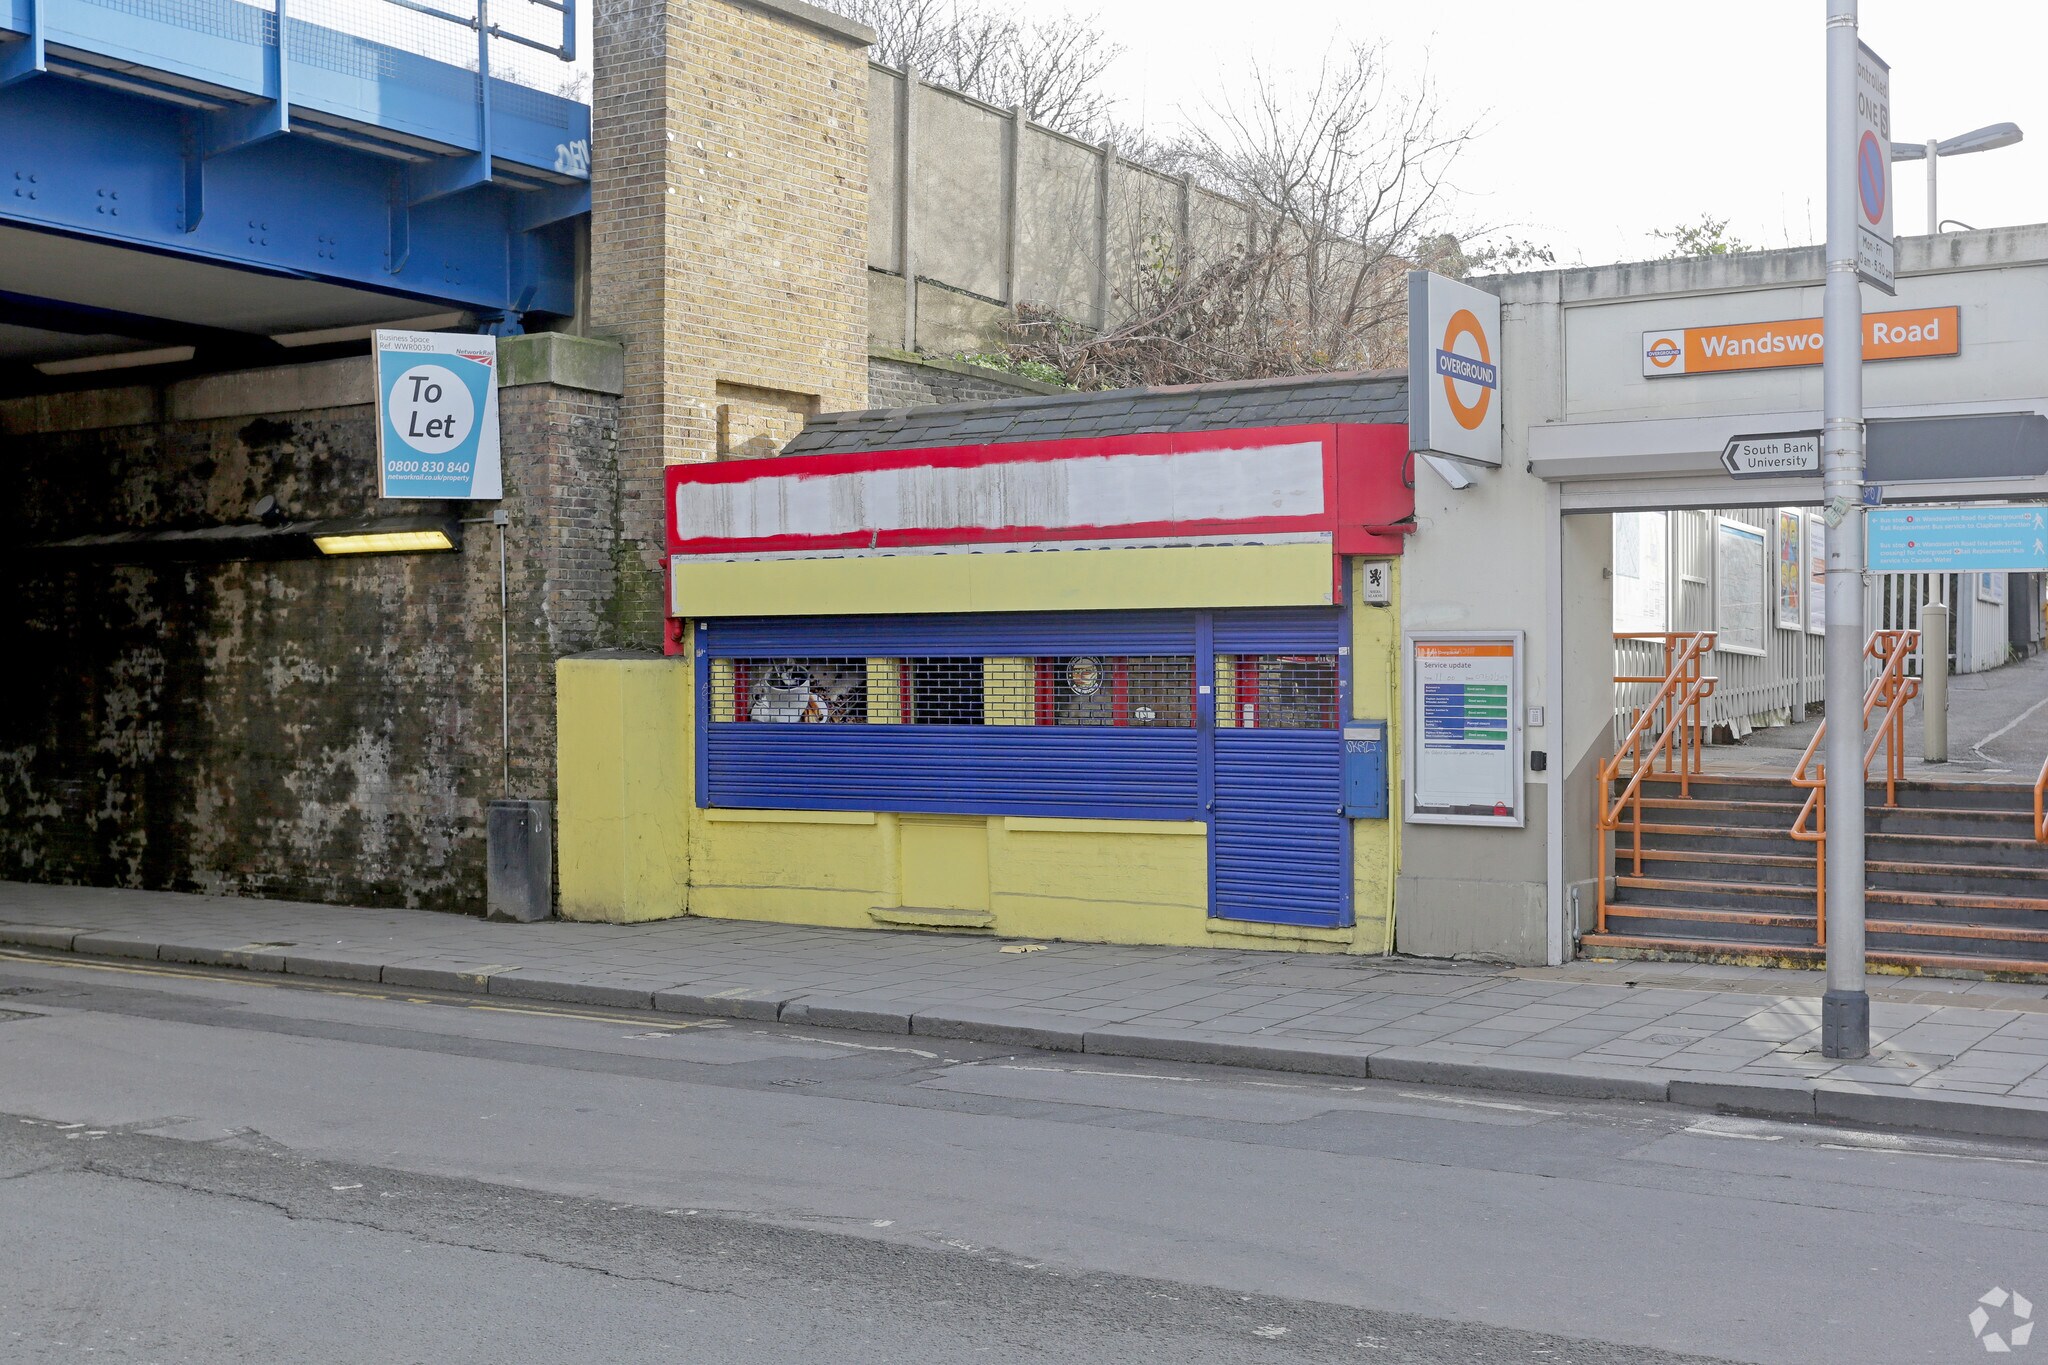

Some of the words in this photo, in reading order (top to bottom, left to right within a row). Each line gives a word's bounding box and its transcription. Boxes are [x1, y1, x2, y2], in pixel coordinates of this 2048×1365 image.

[1858, 63, 1886, 99] ontrolled
[1858, 92, 1878, 127] ONE
[379, 334, 408, 342] Business
[395, 343, 434, 352] WWR00301
[1701, 332, 1864, 358] Wandswo
[1874, 318, 1939, 344] Road
[1440, 355, 1494, 383] OVERGROUND
[408, 376, 442, 403] To
[408, 411, 456, 438] Let
[1744, 444, 1778, 455] South
[1784, 442, 1814, 453] Bank
[388, 461, 418, 472] 0800
[421, 461, 444, 472] 830
[447, 462, 470, 473] 840
[1748, 456, 1807, 468] University
[388, 474, 469, 482] networkrail.co.uk/property
